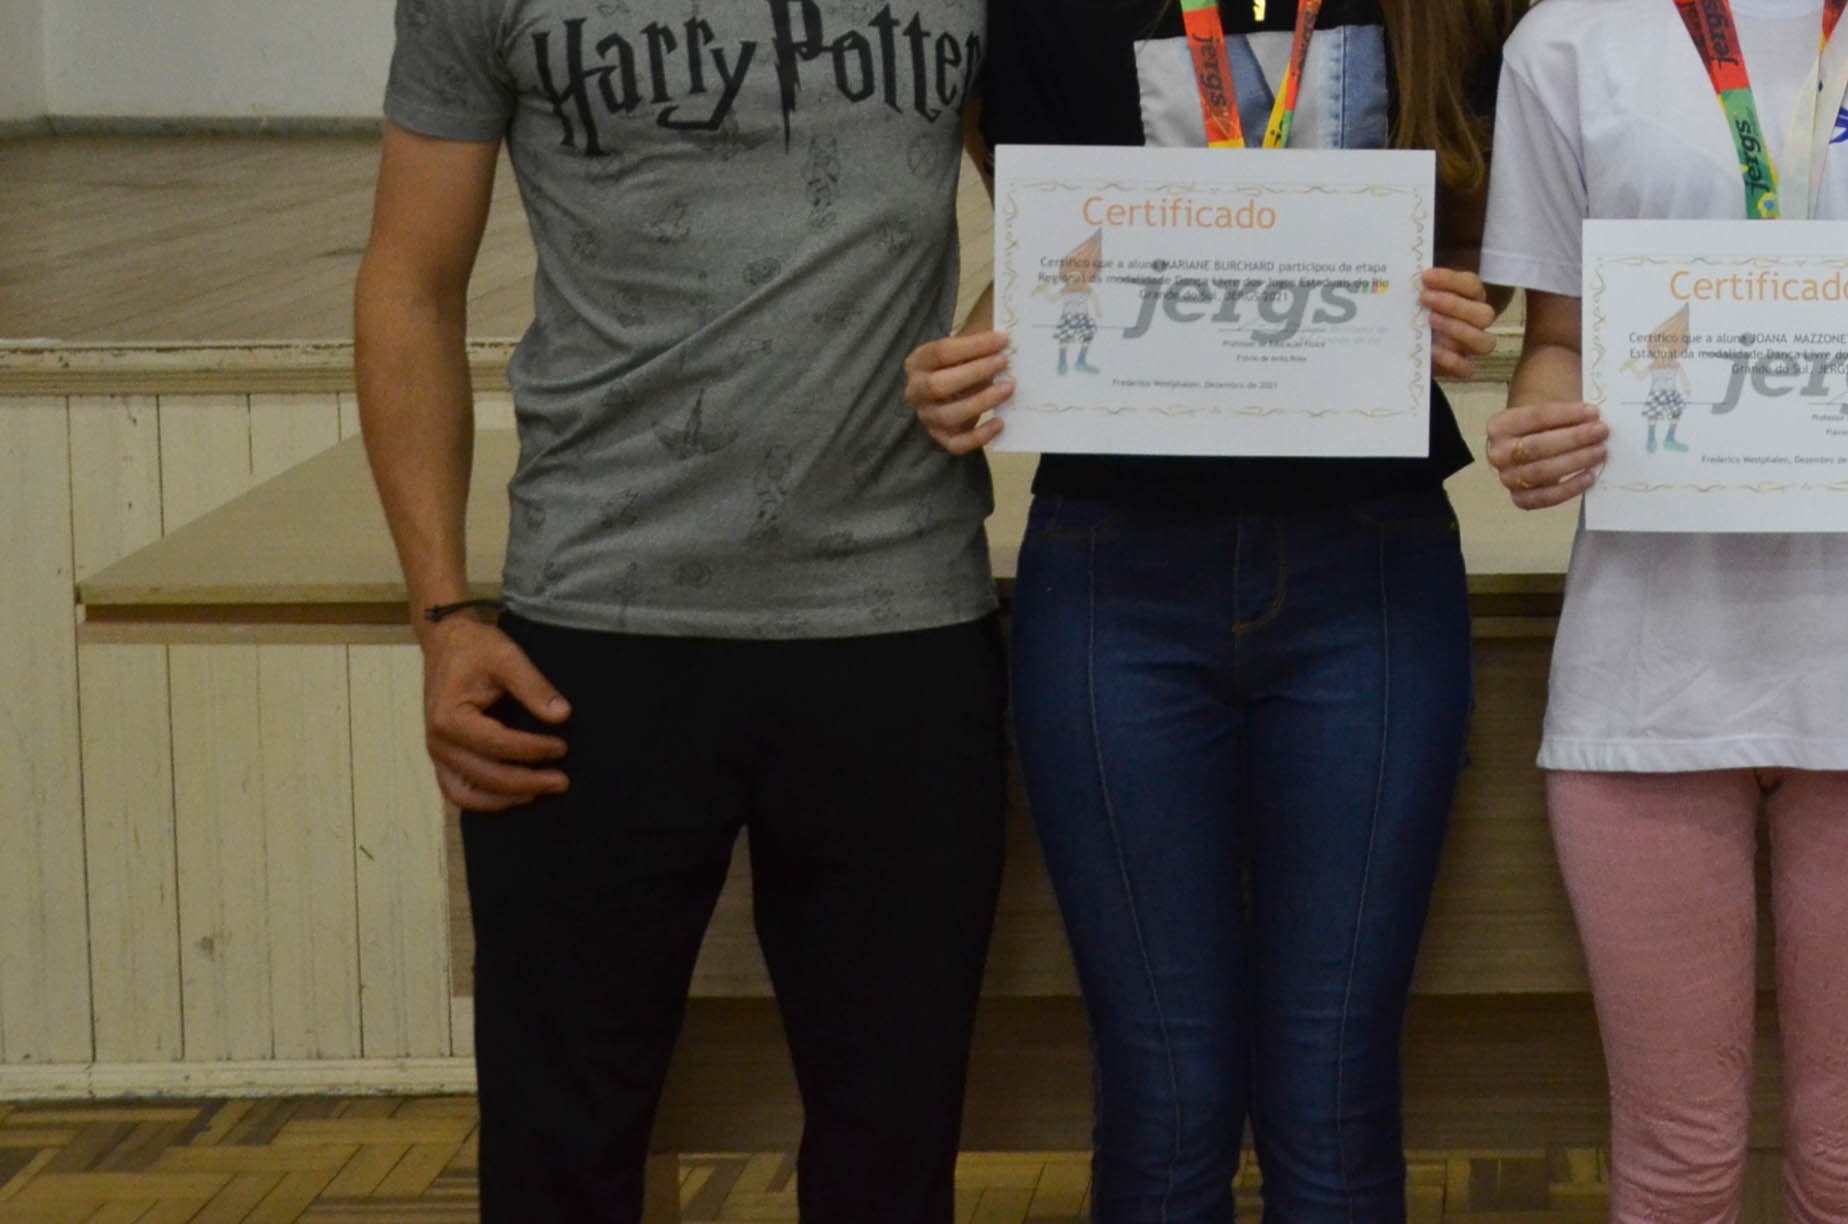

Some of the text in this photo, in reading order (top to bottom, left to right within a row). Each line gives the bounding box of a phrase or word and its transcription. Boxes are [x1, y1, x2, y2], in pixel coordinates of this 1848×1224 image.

[531, 16, 758, 157] Harry
[1193, 33, 1227, 110] jergs
[1736, 119, 1771, 195] jergs
[1082, 196, 1277, 229] Certificado
[1122, 259, 1359, 342] jergs
[1213, 260, 1275, 273] BURCHARD
[1278, 259, 1336, 274] participou
[1338, 260, 1353, 273] da
[1355, 261, 1388, 275] etapa
[1682, 334, 1703, 347] que
[1705, 335, 1713, 344] a
